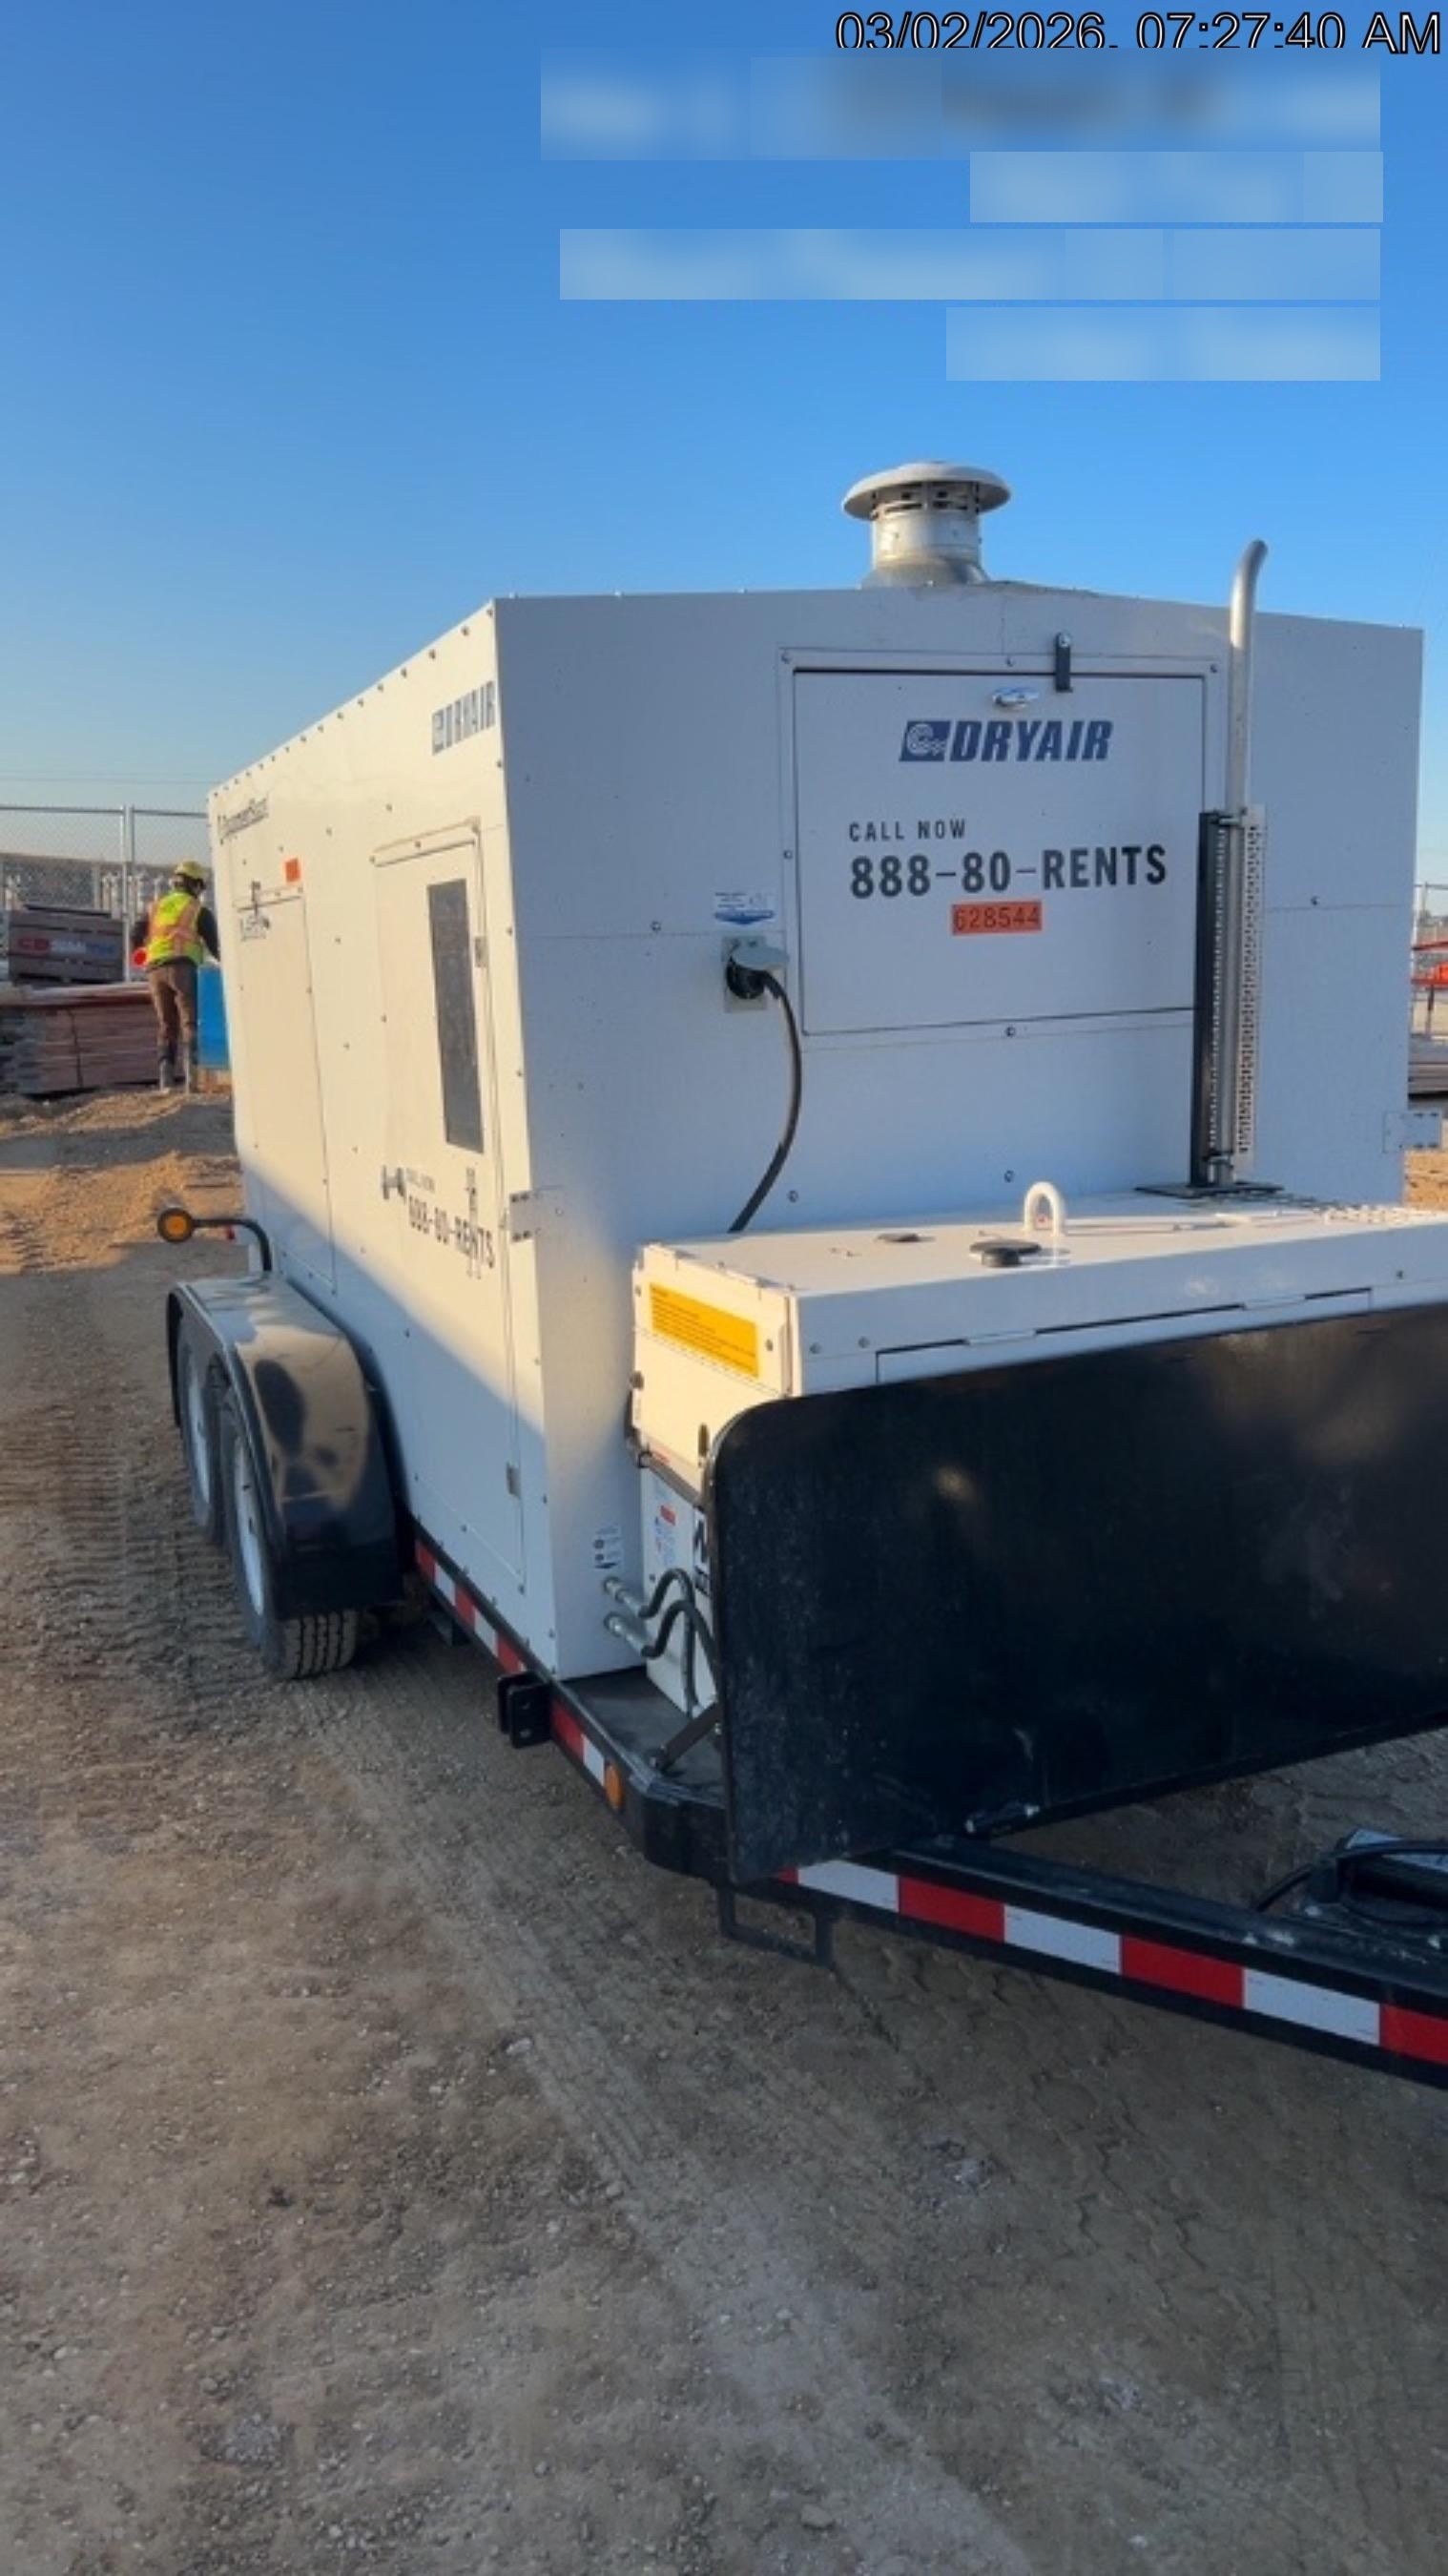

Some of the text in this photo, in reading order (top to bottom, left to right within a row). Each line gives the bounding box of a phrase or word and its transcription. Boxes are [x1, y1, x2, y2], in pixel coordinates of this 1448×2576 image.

[949, 720, 1114, 762] DRYAIR
[849, 819, 966, 841] CALL NOW
[849, 844, 1168, 900] 888-80-RENTS
[954, 905, 1040, 931] 628544
